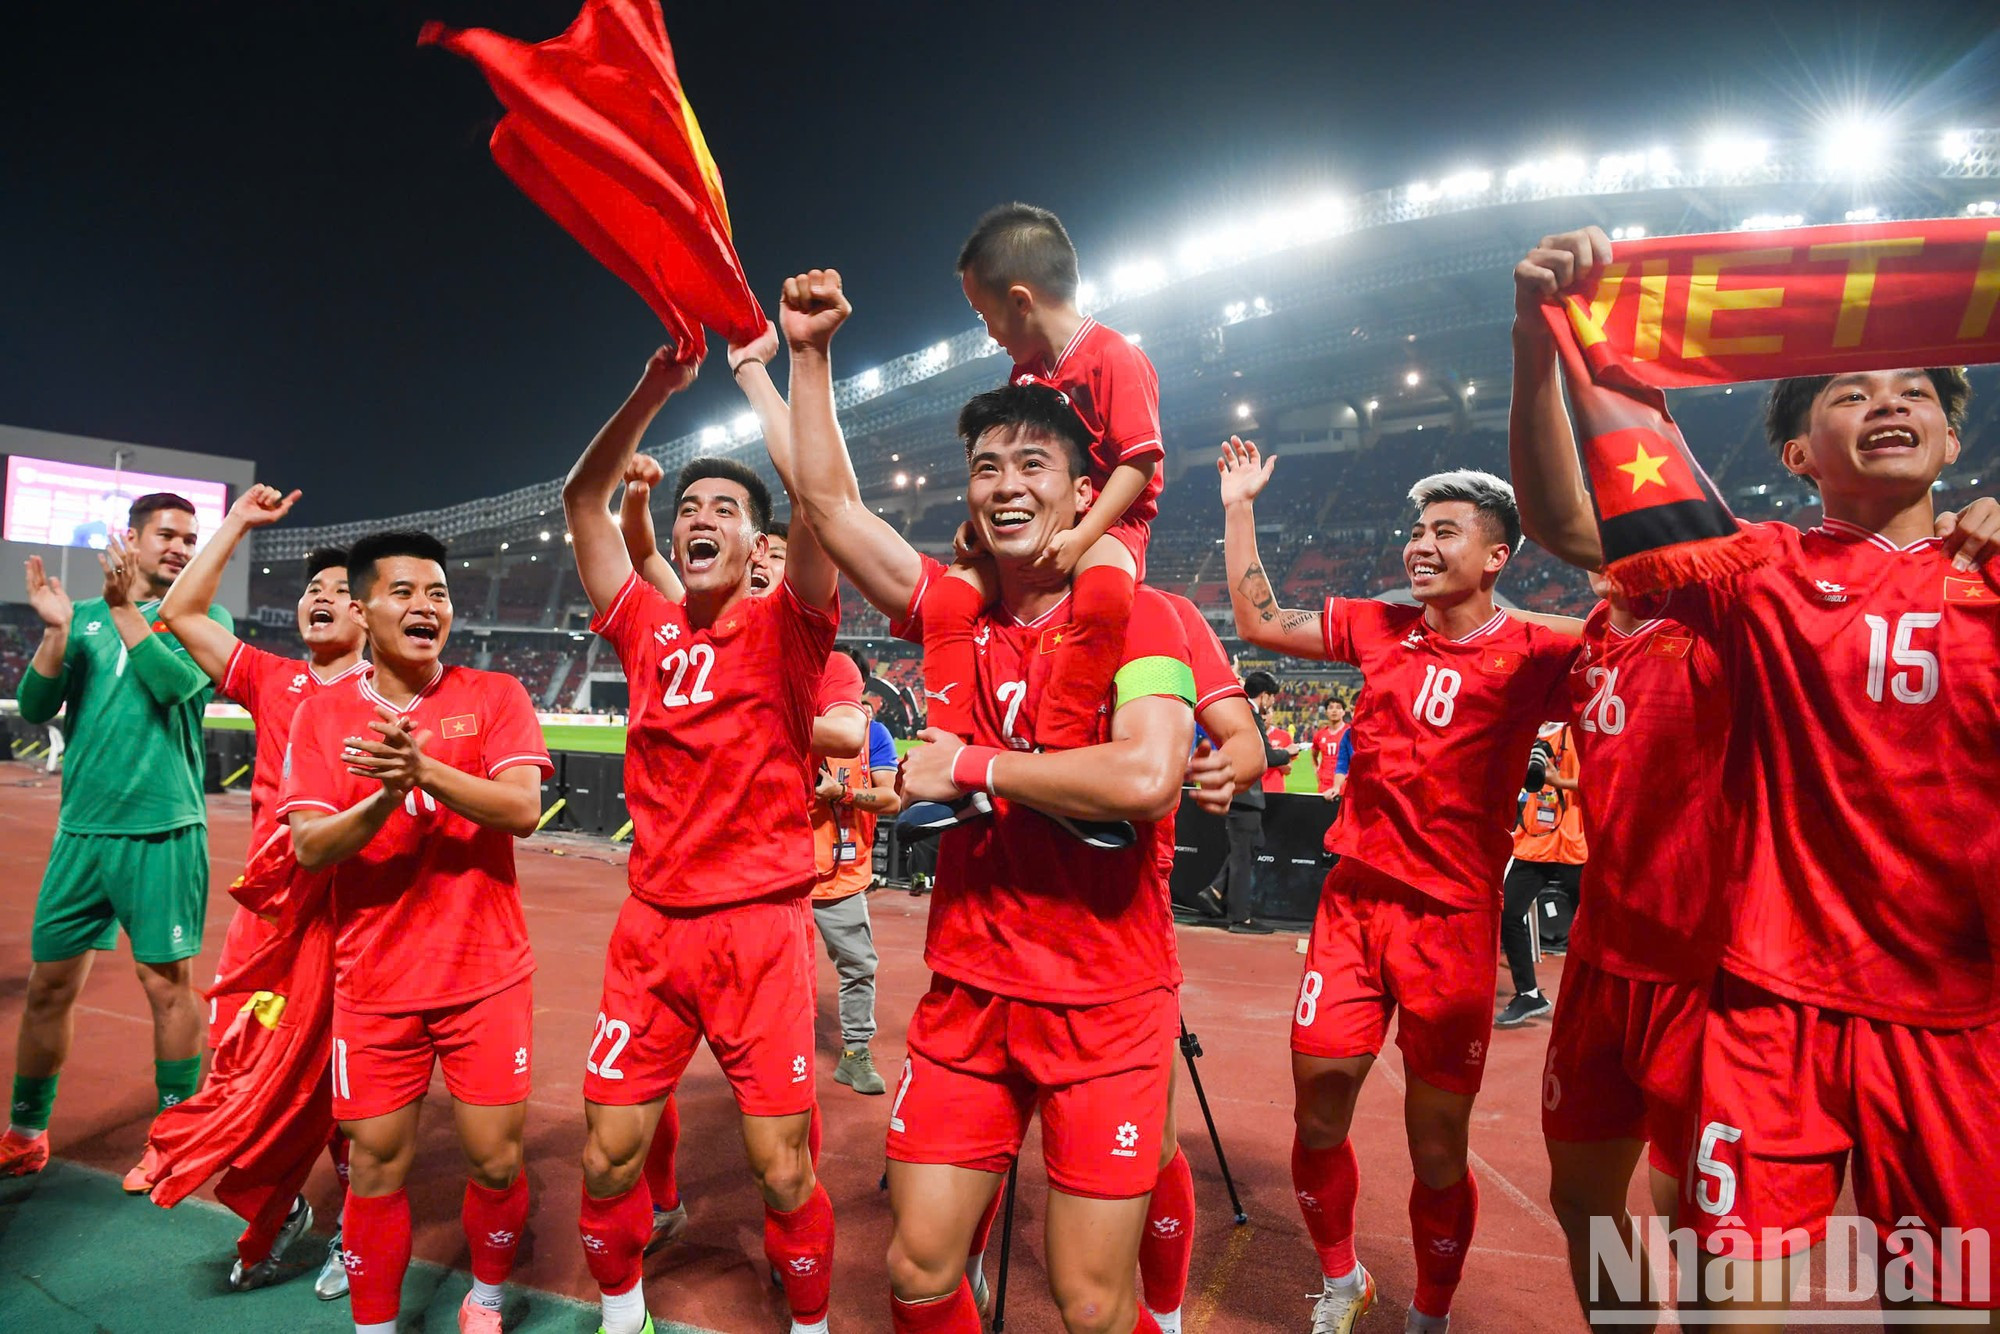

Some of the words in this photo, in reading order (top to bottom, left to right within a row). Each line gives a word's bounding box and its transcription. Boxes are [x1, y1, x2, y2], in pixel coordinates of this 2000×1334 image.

[1567, 237, 1925, 363] VIET
[661, 643, 716, 708] 22
[1864, 612, 1942, 705] 15
[996, 680, 1031, 750] 2
[1412, 664, 1462, 728] 18
[1580, 666, 1626, 736] 26
[1296, 970, 1323, 1028] 8
[587, 1011, 631, 1079] 22
